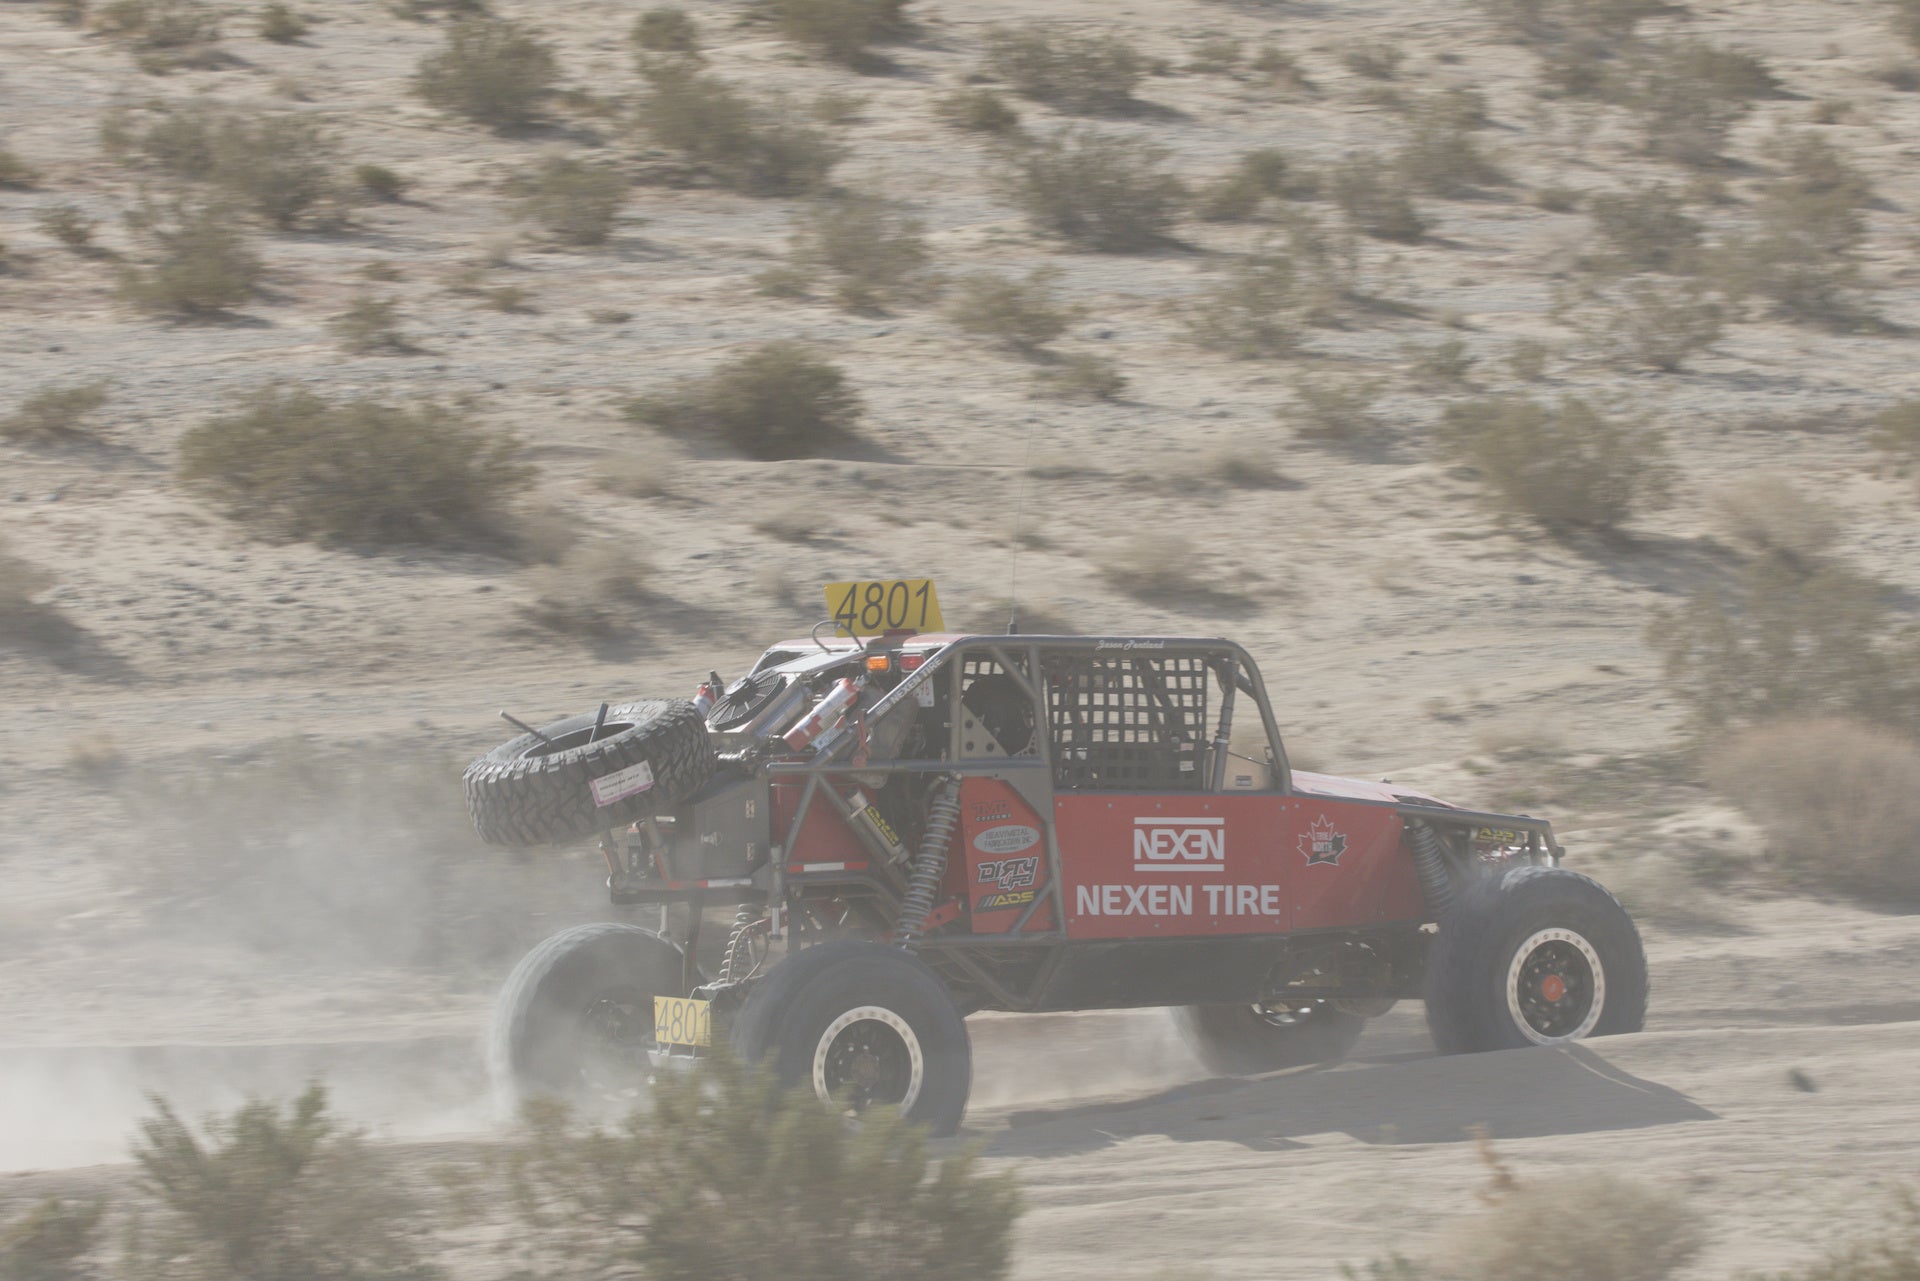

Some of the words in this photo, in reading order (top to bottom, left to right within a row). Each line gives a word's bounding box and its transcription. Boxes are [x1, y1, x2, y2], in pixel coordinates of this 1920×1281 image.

[835, 580, 930, 631] 4801
[889, 675, 922, 704] NEXEN
[919, 656, 943, 677] TIRE
[1134, 829, 1225, 860] NEXEN
[977, 857, 1039, 883] DIRTY
[1077, 885, 1192, 915] NEXEN
[1202, 885, 1280, 915] TIRE
[656, 1000, 709, 1045] 4801
